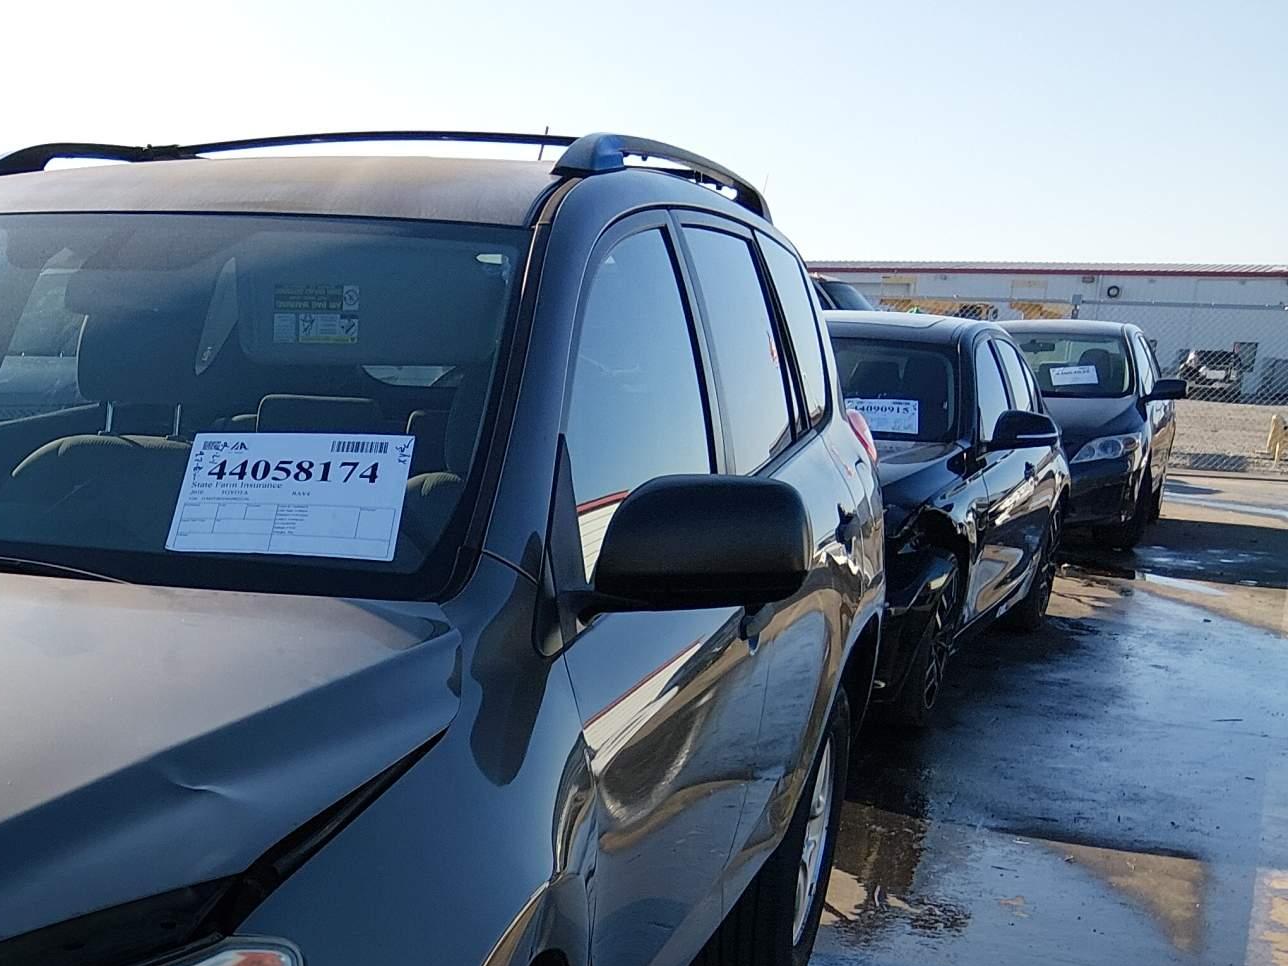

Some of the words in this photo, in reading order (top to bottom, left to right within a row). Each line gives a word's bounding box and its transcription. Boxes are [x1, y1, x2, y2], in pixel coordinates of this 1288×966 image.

[207, 459, 380, 484] 44058174
[191, 481, 213, 489] State
[215, 481, 238, 489] Farm
[240, 481, 283, 489] Insurance
